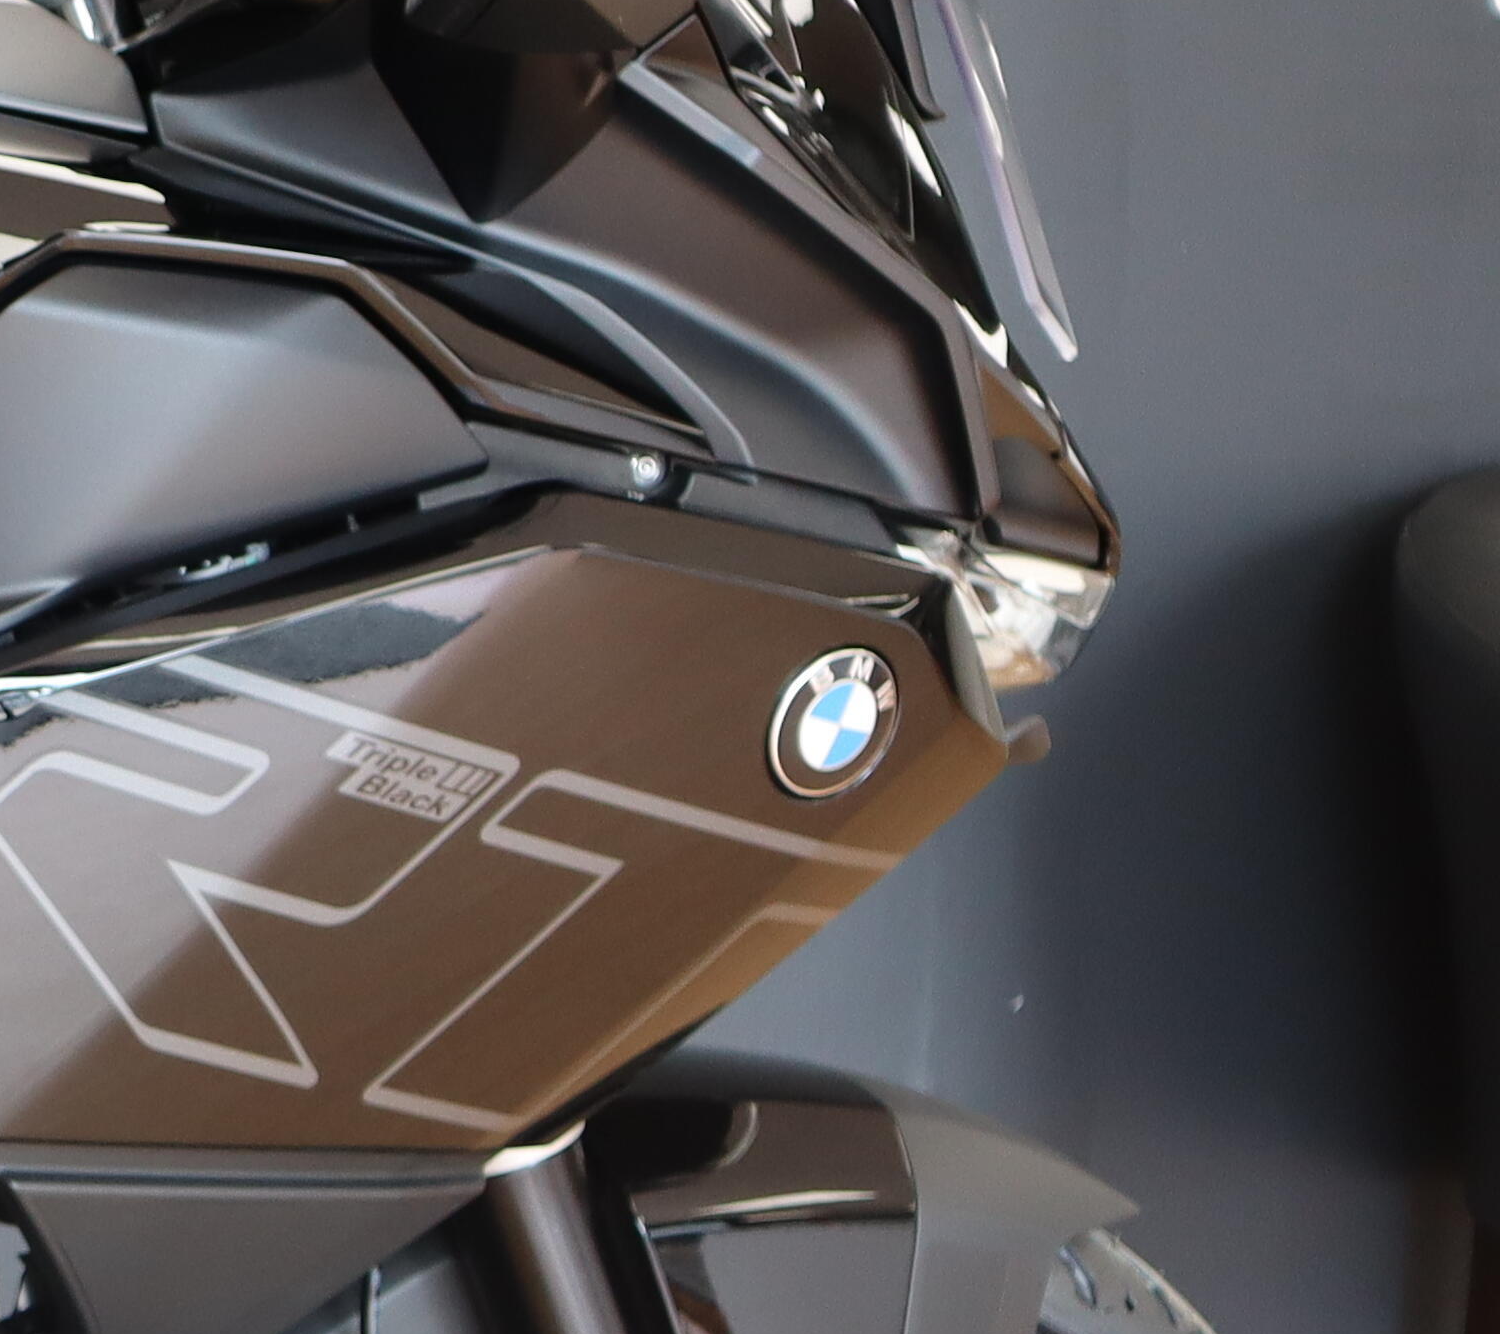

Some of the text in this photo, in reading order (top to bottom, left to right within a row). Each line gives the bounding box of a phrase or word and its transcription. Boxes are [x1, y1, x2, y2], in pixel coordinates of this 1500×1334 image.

[808, 653, 897, 714] BMW
[347, 736, 439, 781] Triple
[356, 773, 450, 816] Black
